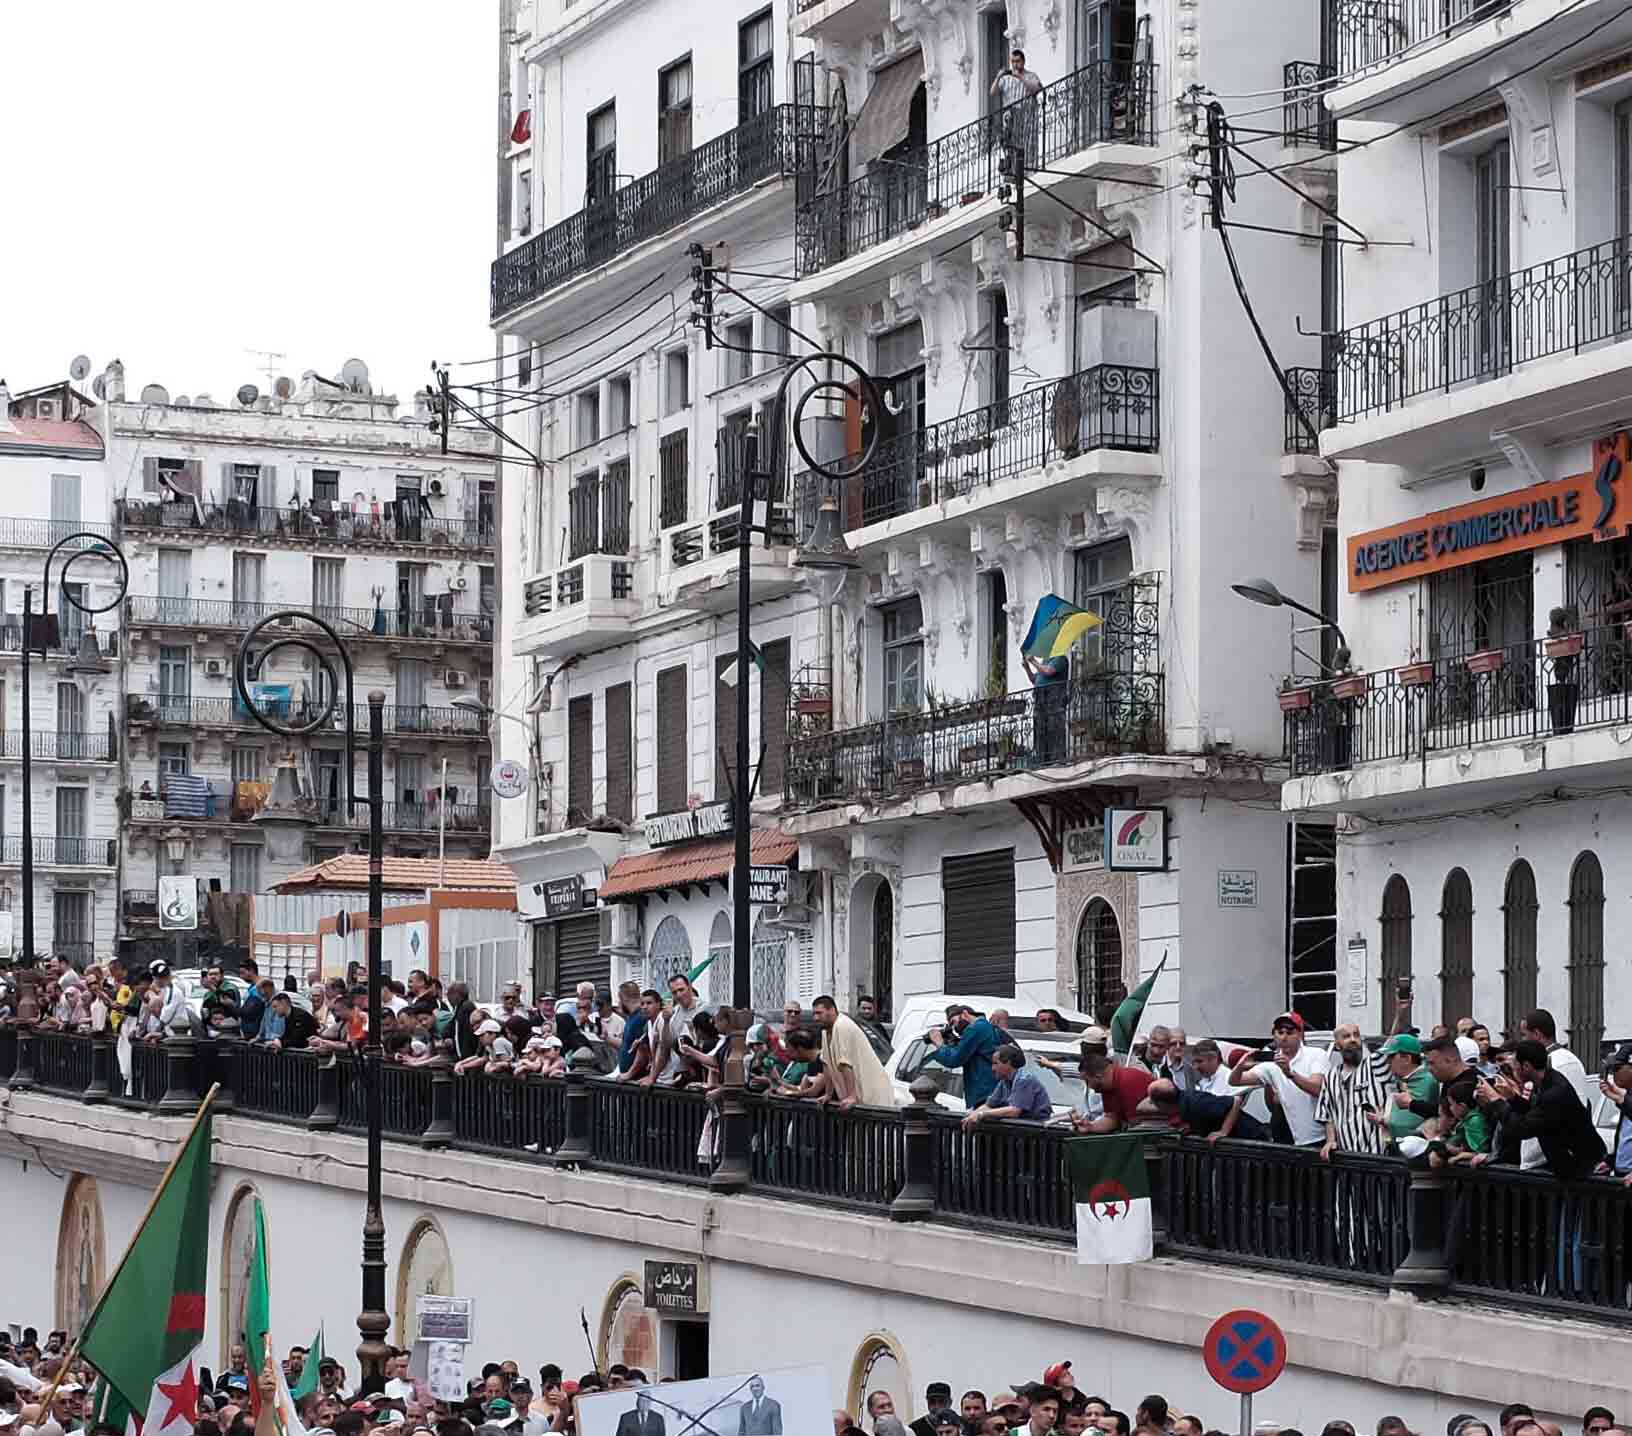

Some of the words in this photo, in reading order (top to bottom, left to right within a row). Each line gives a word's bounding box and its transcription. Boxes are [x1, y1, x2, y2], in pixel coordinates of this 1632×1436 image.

[1355, 530, 1428, 576] AGENCE
[1431, 490, 1580, 557] COMMERCIALE
[655, 1292, 694, 1308] TOILETTES
